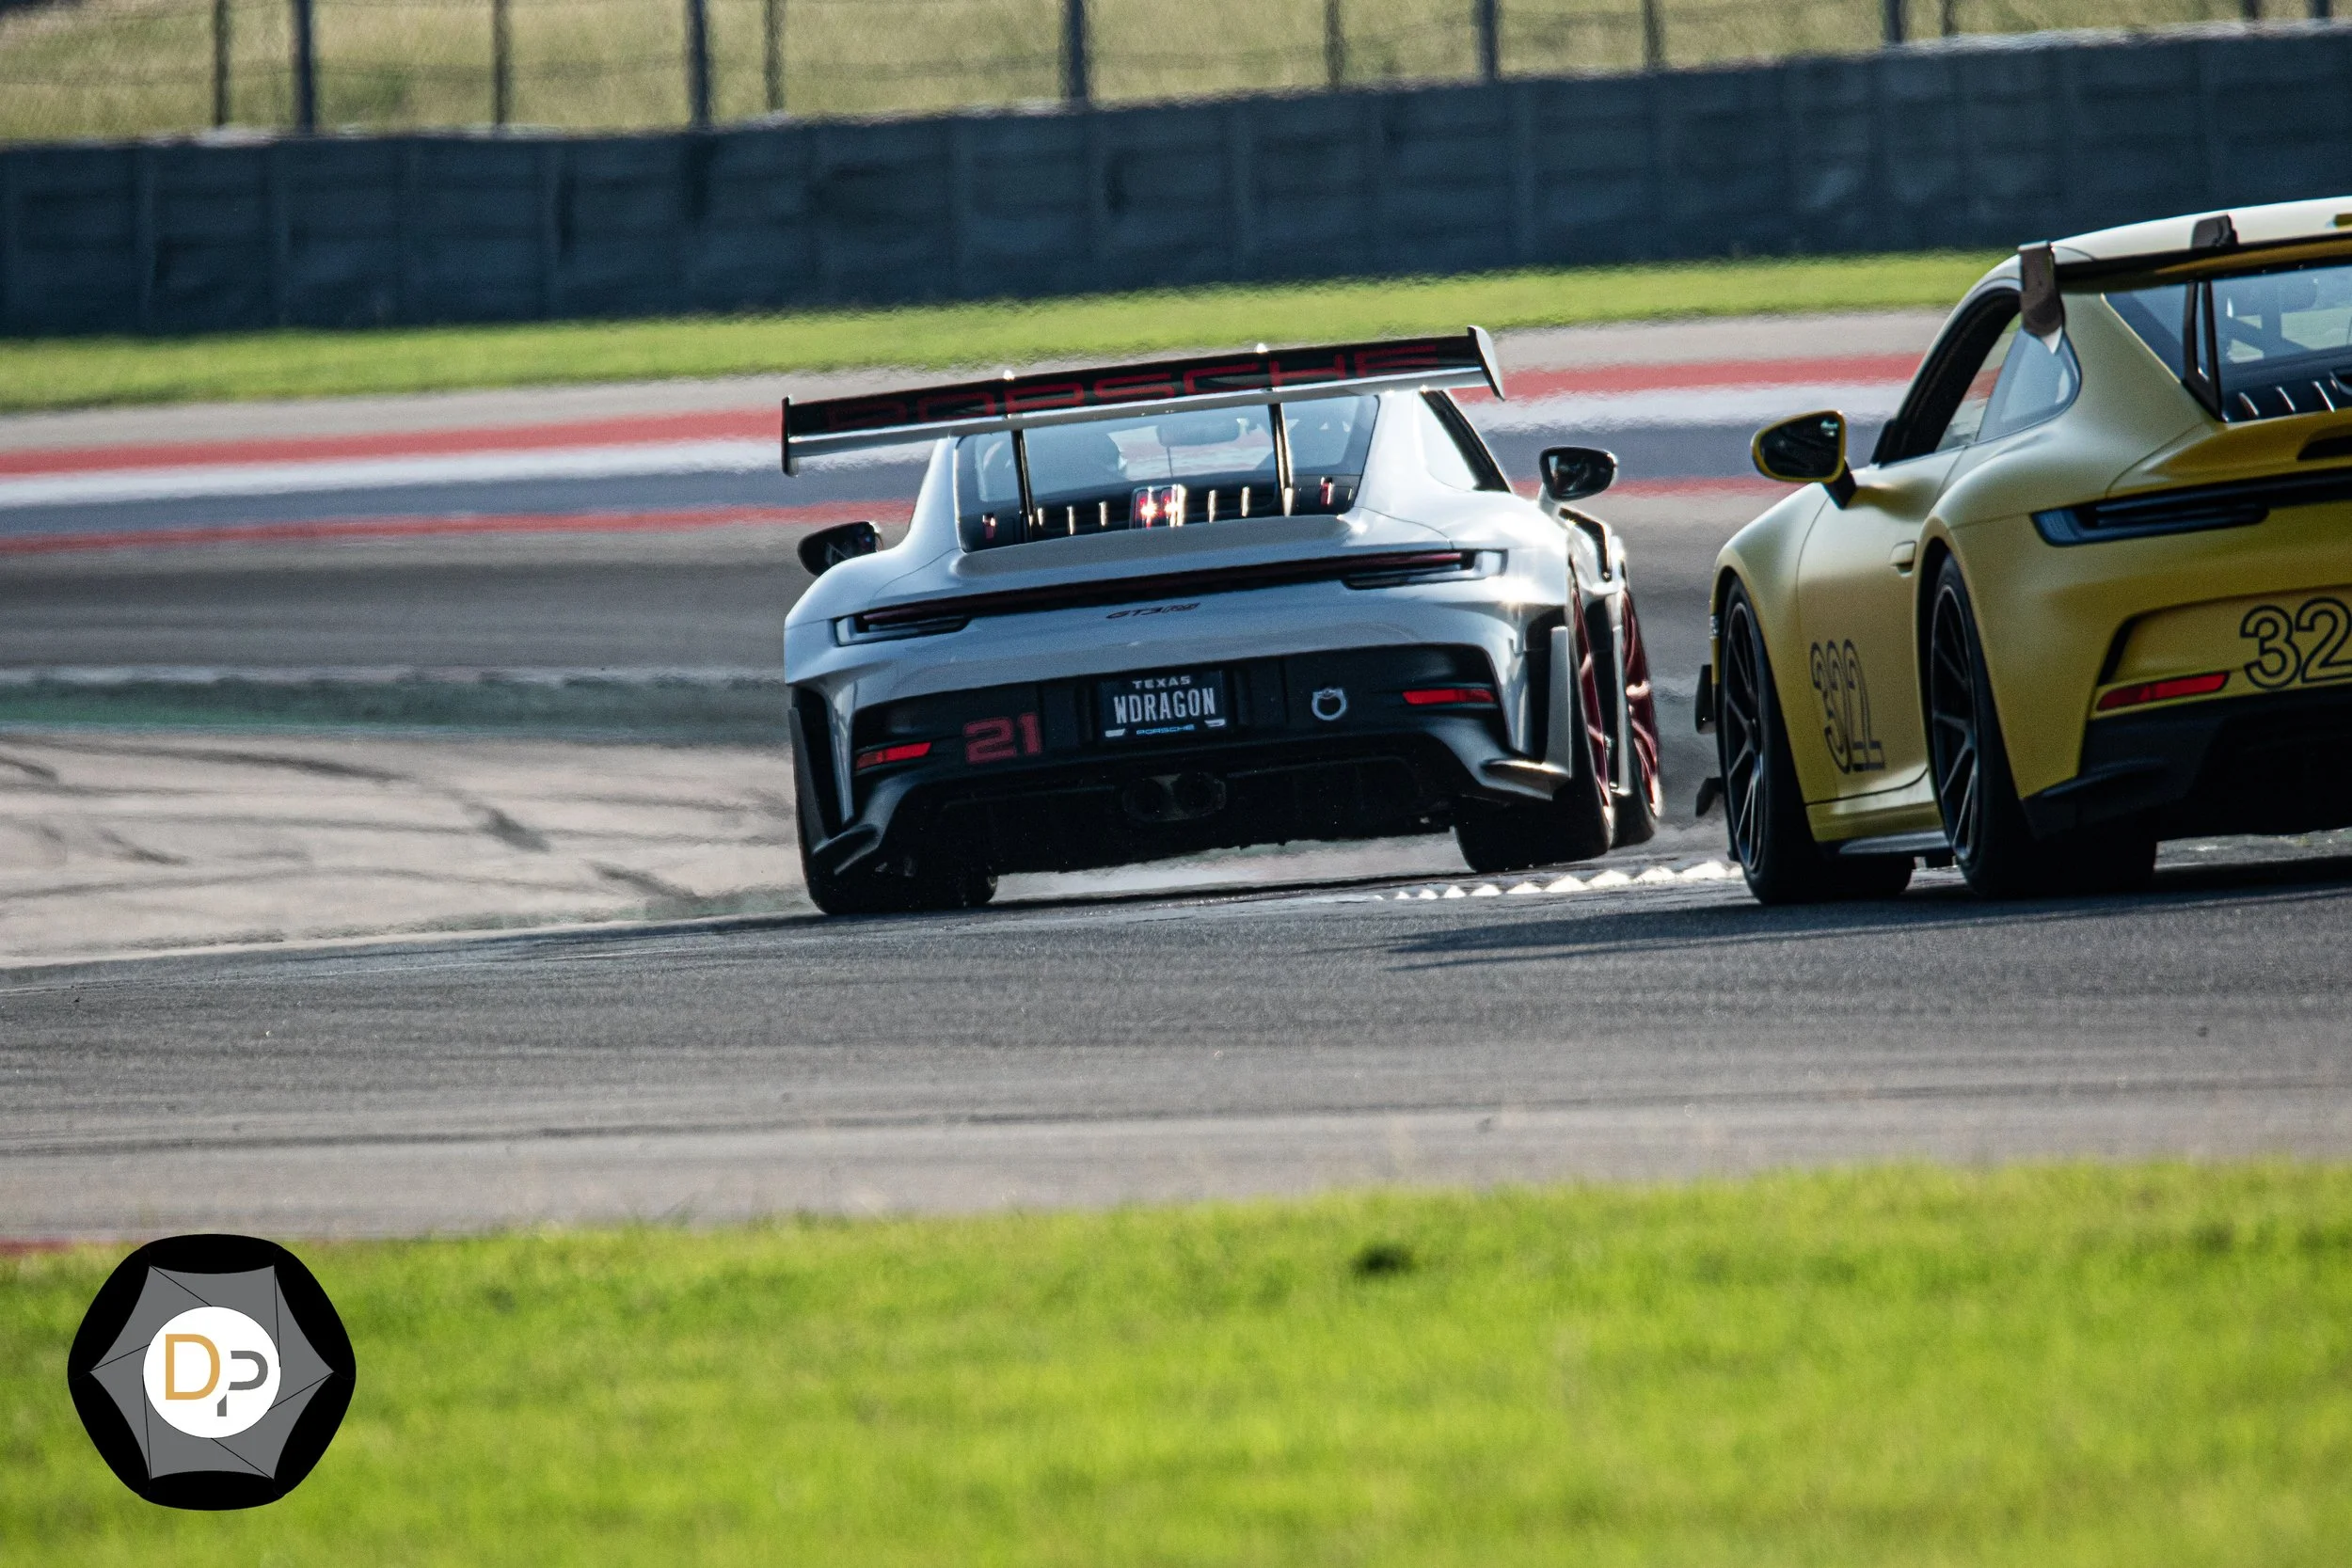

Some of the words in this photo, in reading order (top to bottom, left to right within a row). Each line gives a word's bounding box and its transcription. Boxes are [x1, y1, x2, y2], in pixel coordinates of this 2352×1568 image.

[1132, 675, 1191, 689] TEXAS
[1114, 688, 1216, 724] WDRAGON
[1810, 639, 1885, 774] 322
[963, 713, 1041, 764] 21
[1136, 723, 1196, 736] PORSCHE
